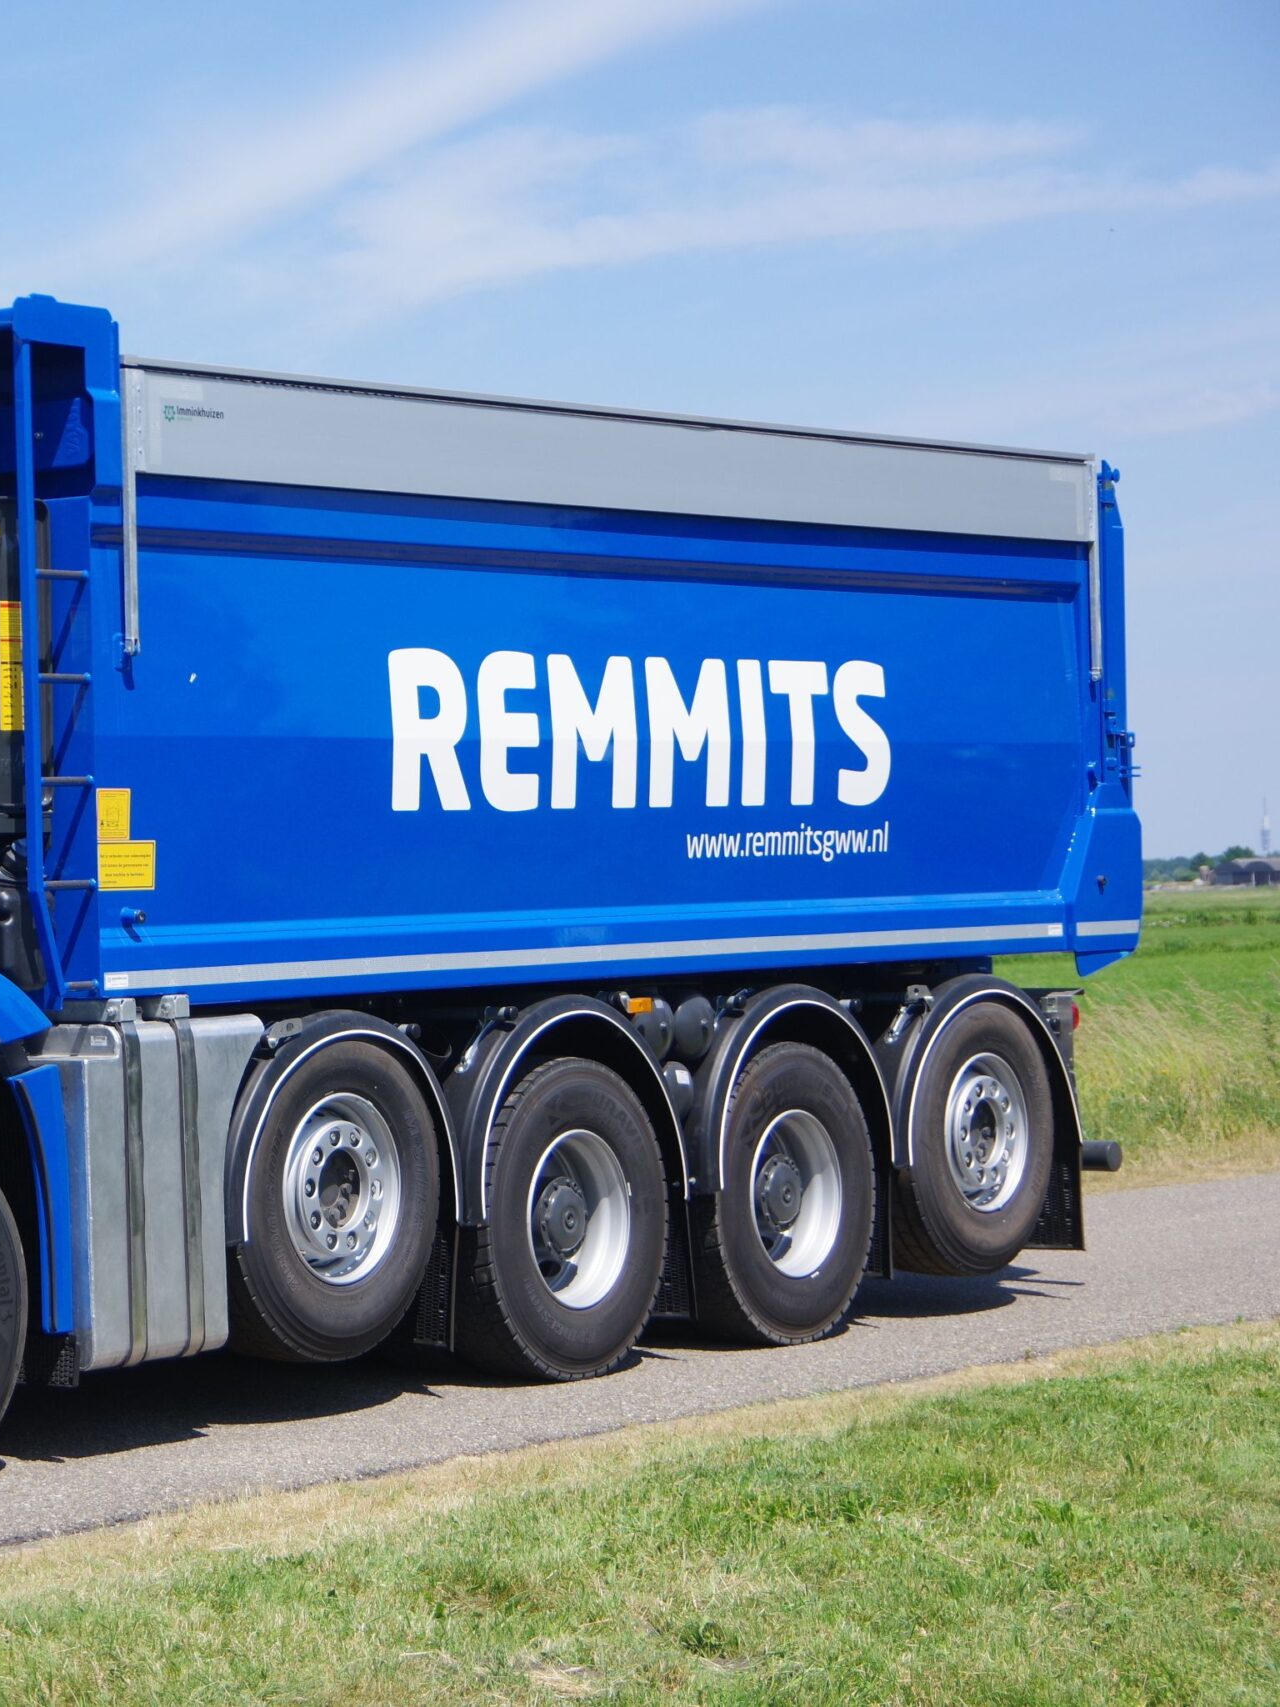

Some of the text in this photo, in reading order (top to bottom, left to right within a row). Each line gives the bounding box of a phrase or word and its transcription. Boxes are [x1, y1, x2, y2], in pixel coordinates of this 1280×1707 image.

[176, 405, 225, 419] Imminkhuizen
[387, 647, 892, 812] REMMITS
[686, 821, 889, 861] www.remmitsgww.nl
